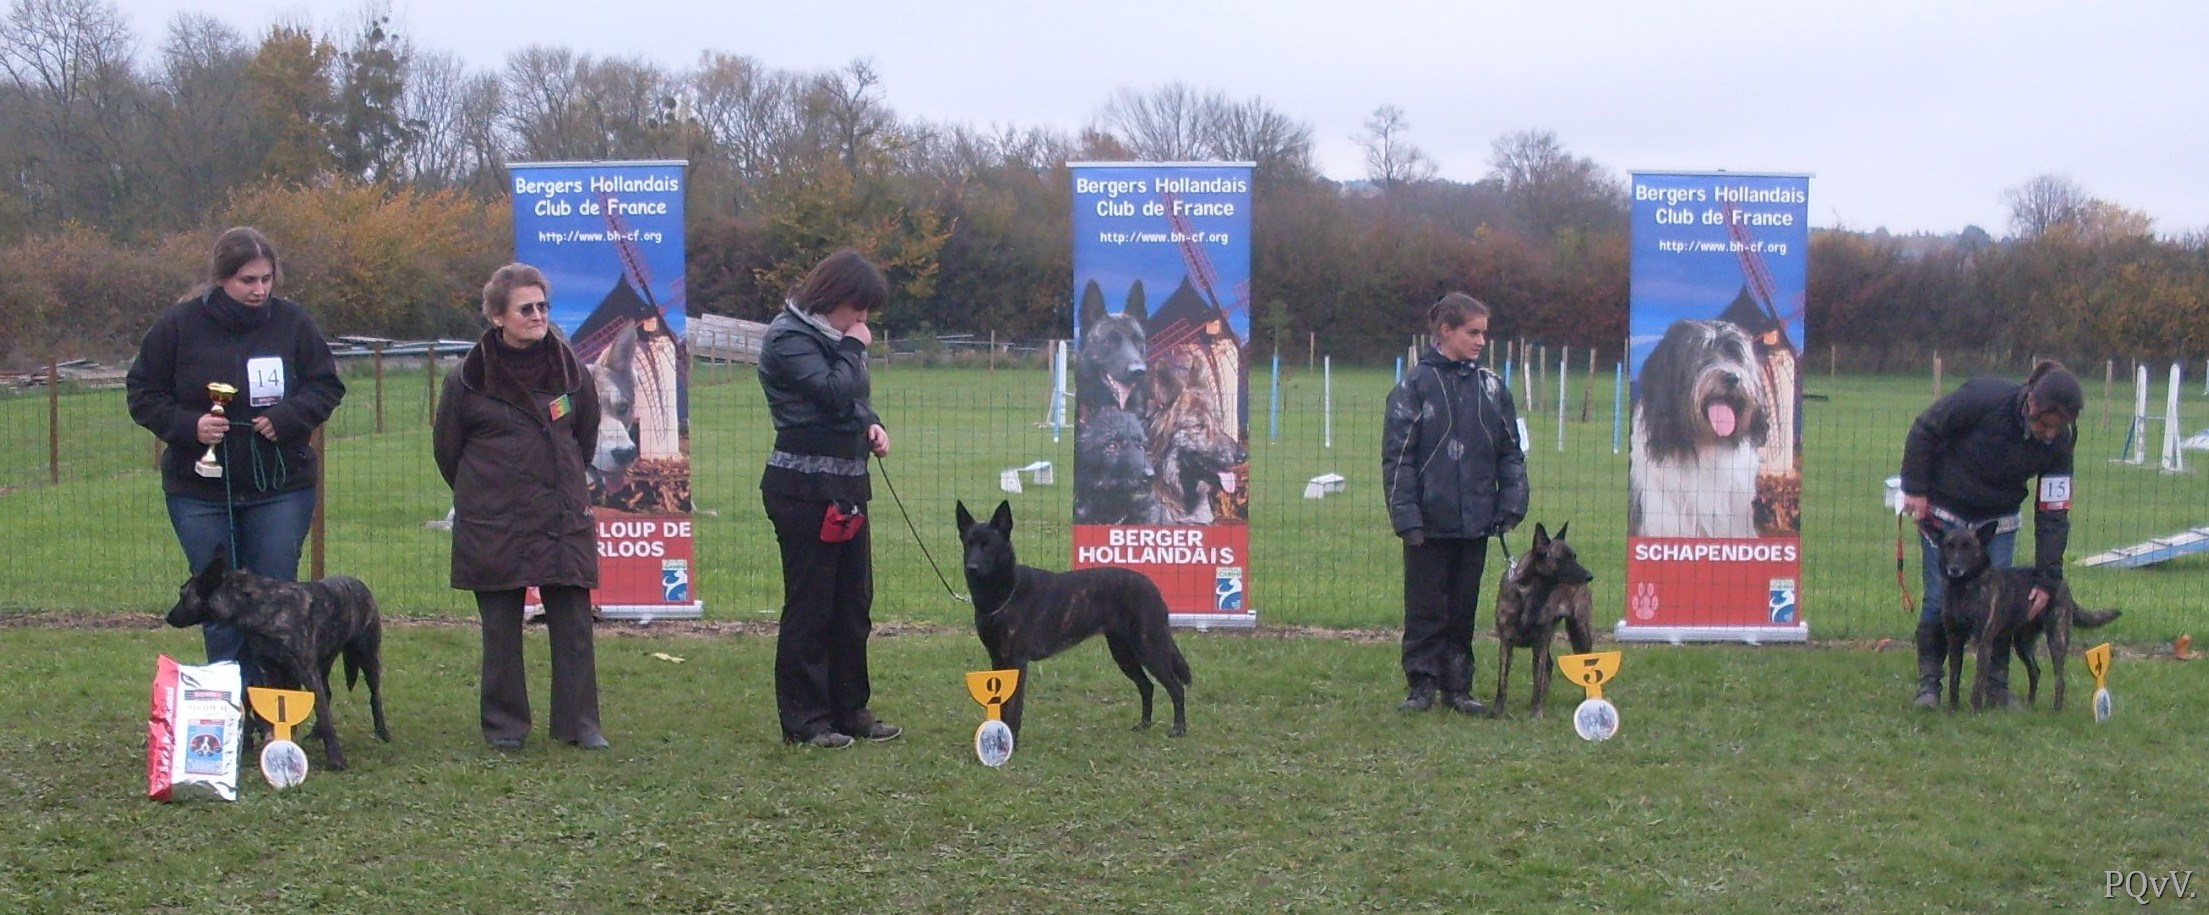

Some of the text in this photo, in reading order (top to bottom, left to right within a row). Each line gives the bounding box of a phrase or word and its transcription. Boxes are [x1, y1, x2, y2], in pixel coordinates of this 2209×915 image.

[515, 175, 679, 198] Bergers Hollandais
[1076, 177, 1247, 198] Bergers Hollandais
[1635, 185, 1805, 206] Bergers Hollandais
[534, 198, 667, 217] Club de France
[1096, 200, 1234, 217] Club de France
[1655, 208, 1793, 226] Club de France
[538, 230, 662, 245] http://www.bh-cf.org
[1100, 231, 1229, 246] http://www.bh-cf.org
[1659, 239, 1787, 256] http://www.bh-cf.org
[258, 368, 281, 388] 14
[2047, 481, 2066, 498] 15
[663, 521, 691, 538] DE
[1109, 529, 1203, 547] BERGER
[1078, 546, 1234, 565] HOLLANDAIS
[1635, 544, 1796, 562] SCHAPENDOES
[986, 677, 1002, 705] 2
[277, 695, 286, 723] 1
